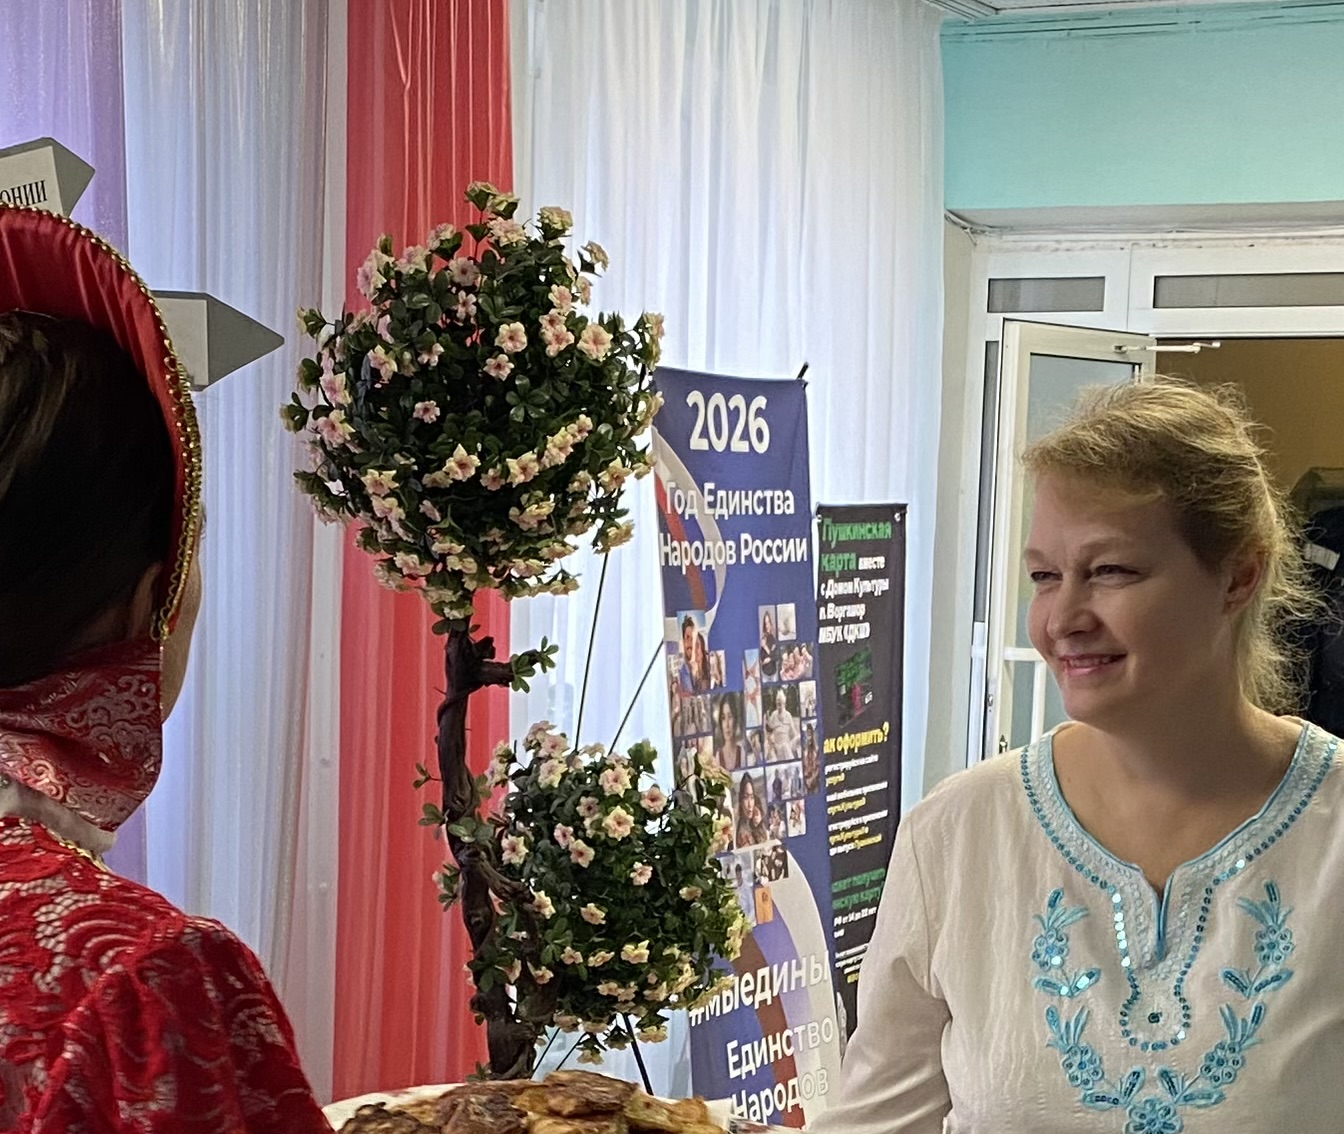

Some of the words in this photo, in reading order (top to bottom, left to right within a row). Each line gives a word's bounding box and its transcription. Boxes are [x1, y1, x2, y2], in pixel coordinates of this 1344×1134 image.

[686, 390, 770, 454] 2026
[666, 481, 699, 520] Год
[704, 482, 795, 520] Единства
[659, 532, 737, 575] Народов
[740, 532, 808, 564] России
[822, 518, 892, 549] Пушкинская
[823, 738, 836, 754] ак
[726, 1017, 834, 1080] Единство
[732, 1068, 829, 1126] Народов
